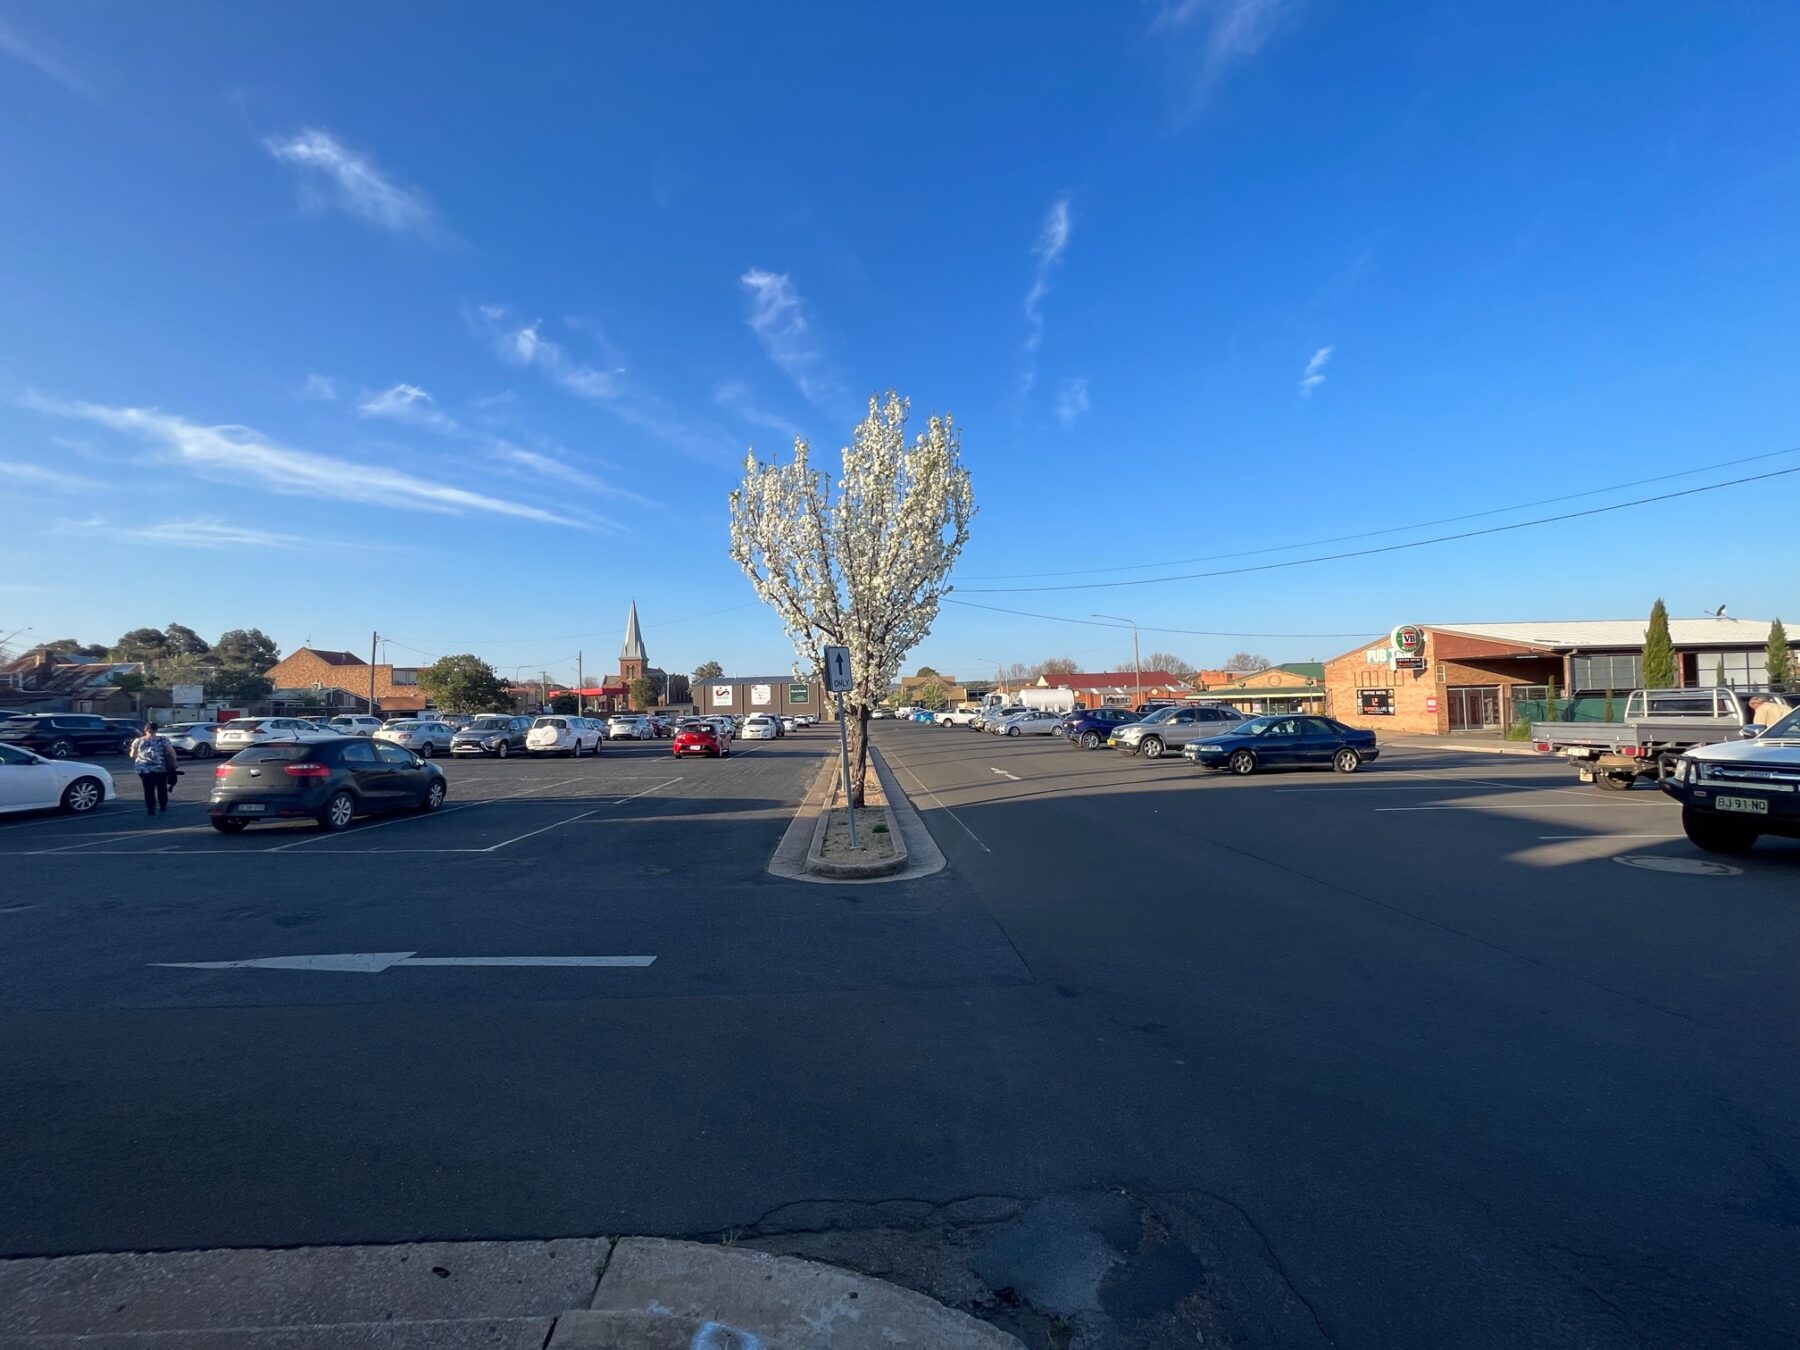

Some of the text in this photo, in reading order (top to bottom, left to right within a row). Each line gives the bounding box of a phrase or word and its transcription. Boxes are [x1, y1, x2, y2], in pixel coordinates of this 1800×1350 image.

[1404, 635, 1416, 643] VB
[1366, 649, 1388, 662] PUB
[833, 679, 850, 688] ONLY
[1718, 798, 1732, 808] BJ
[1735, 799, 1748, 809] 91
